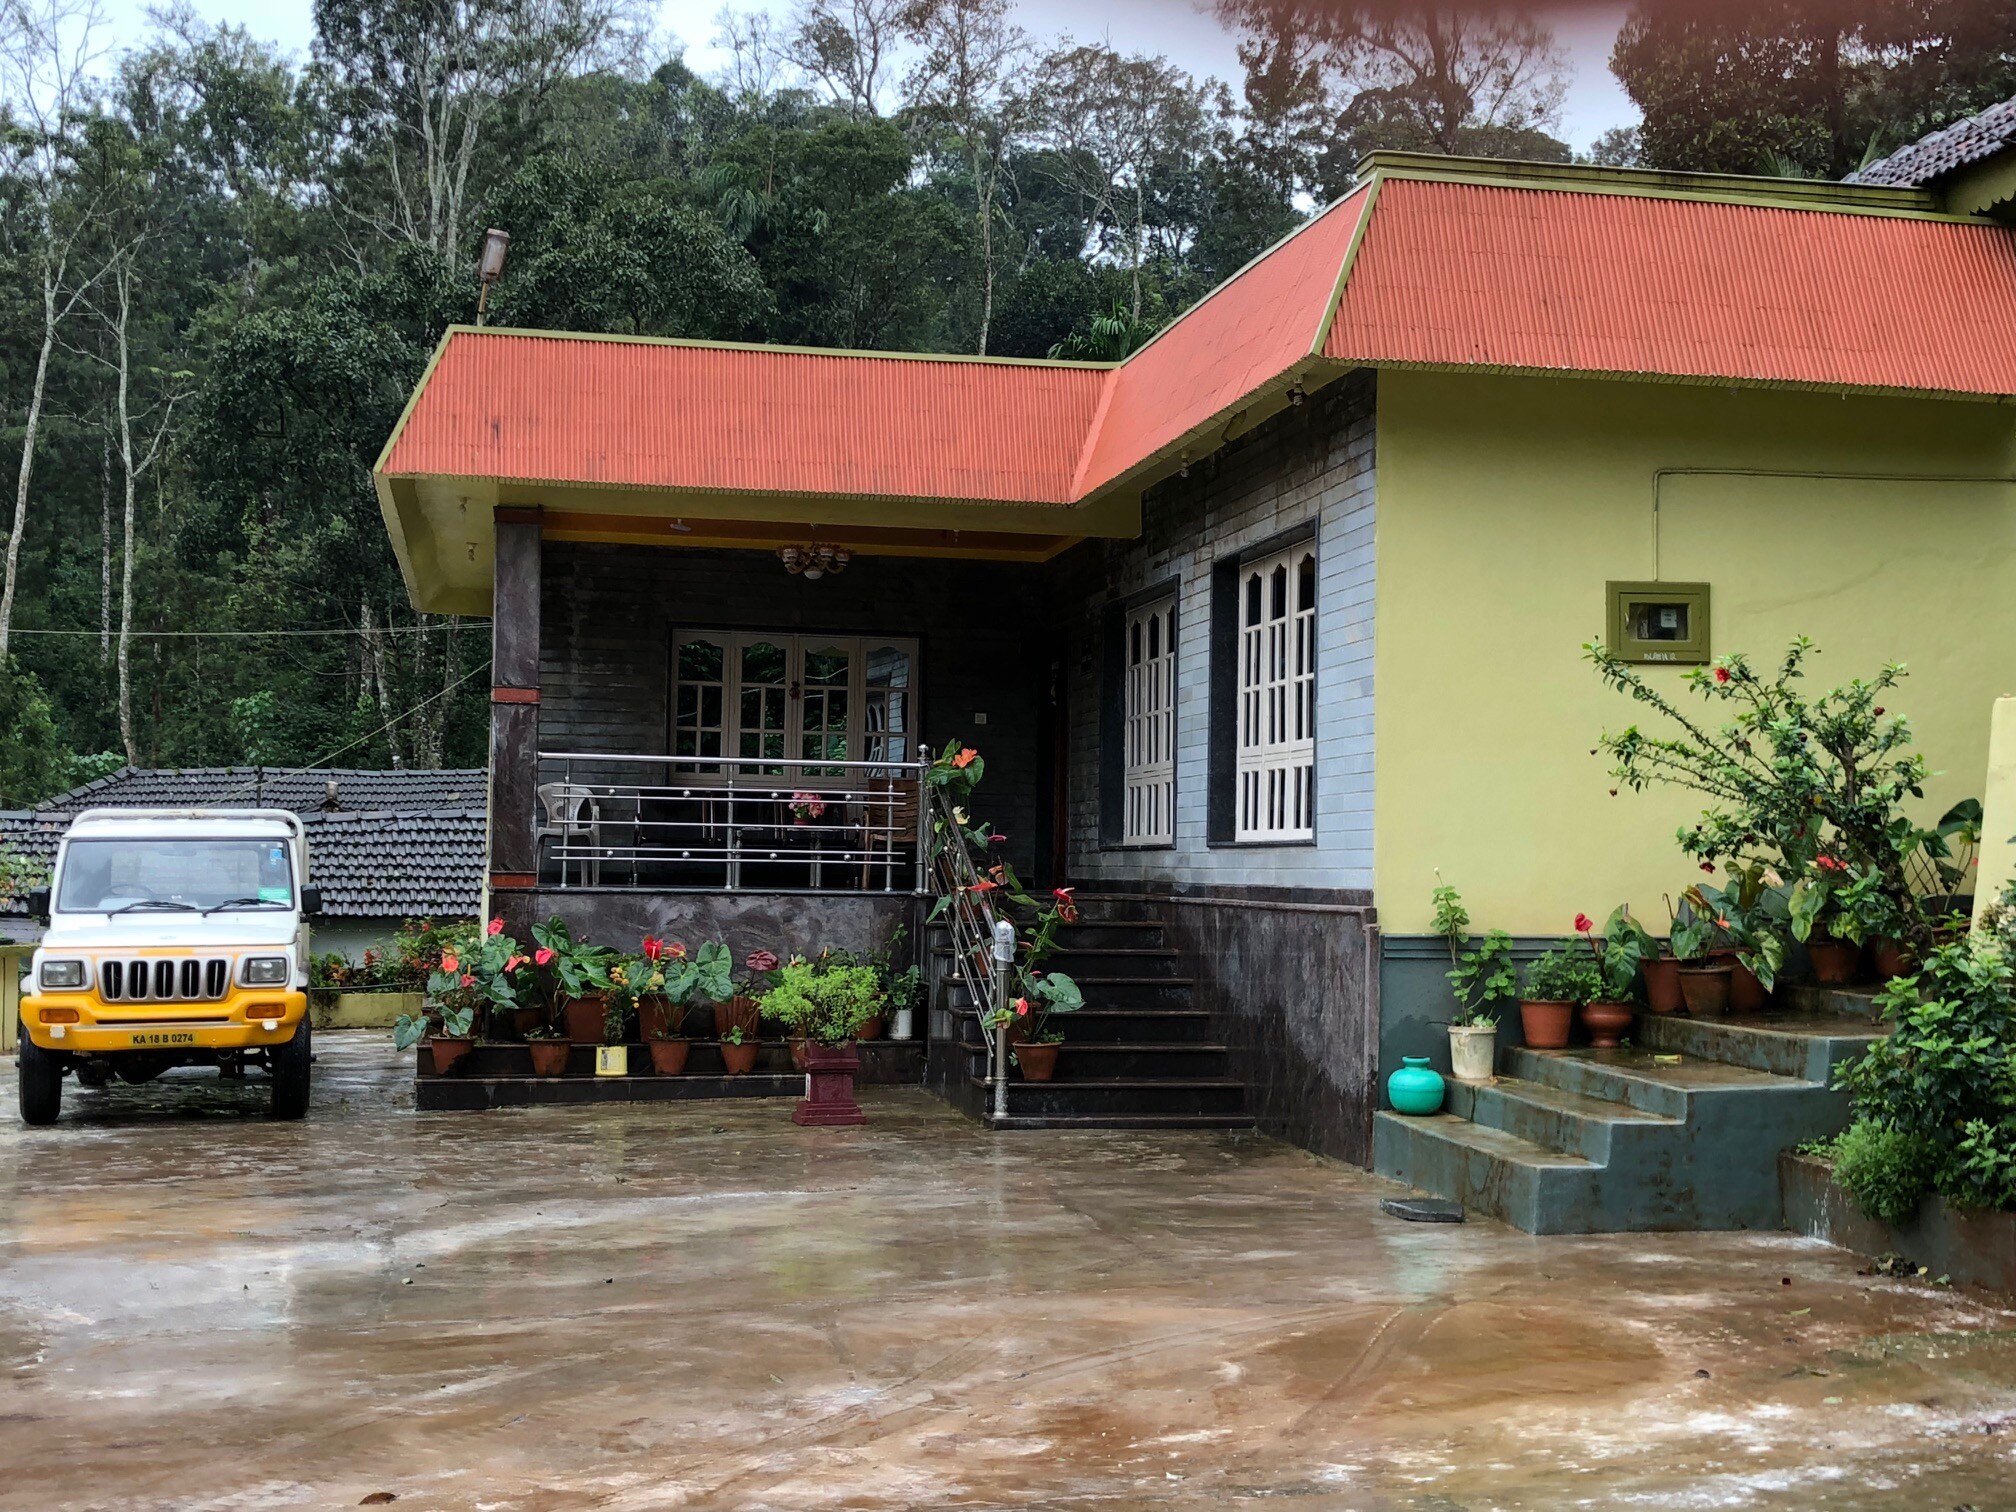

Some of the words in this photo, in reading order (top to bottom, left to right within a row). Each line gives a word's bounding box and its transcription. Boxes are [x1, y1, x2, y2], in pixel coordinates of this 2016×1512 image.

[133, 1035, 146, 1044] KA
[149, 1034, 160, 1043] 18
[162, 1034, 169, 1043] B
[171, 1033, 193, 1043] 0274
